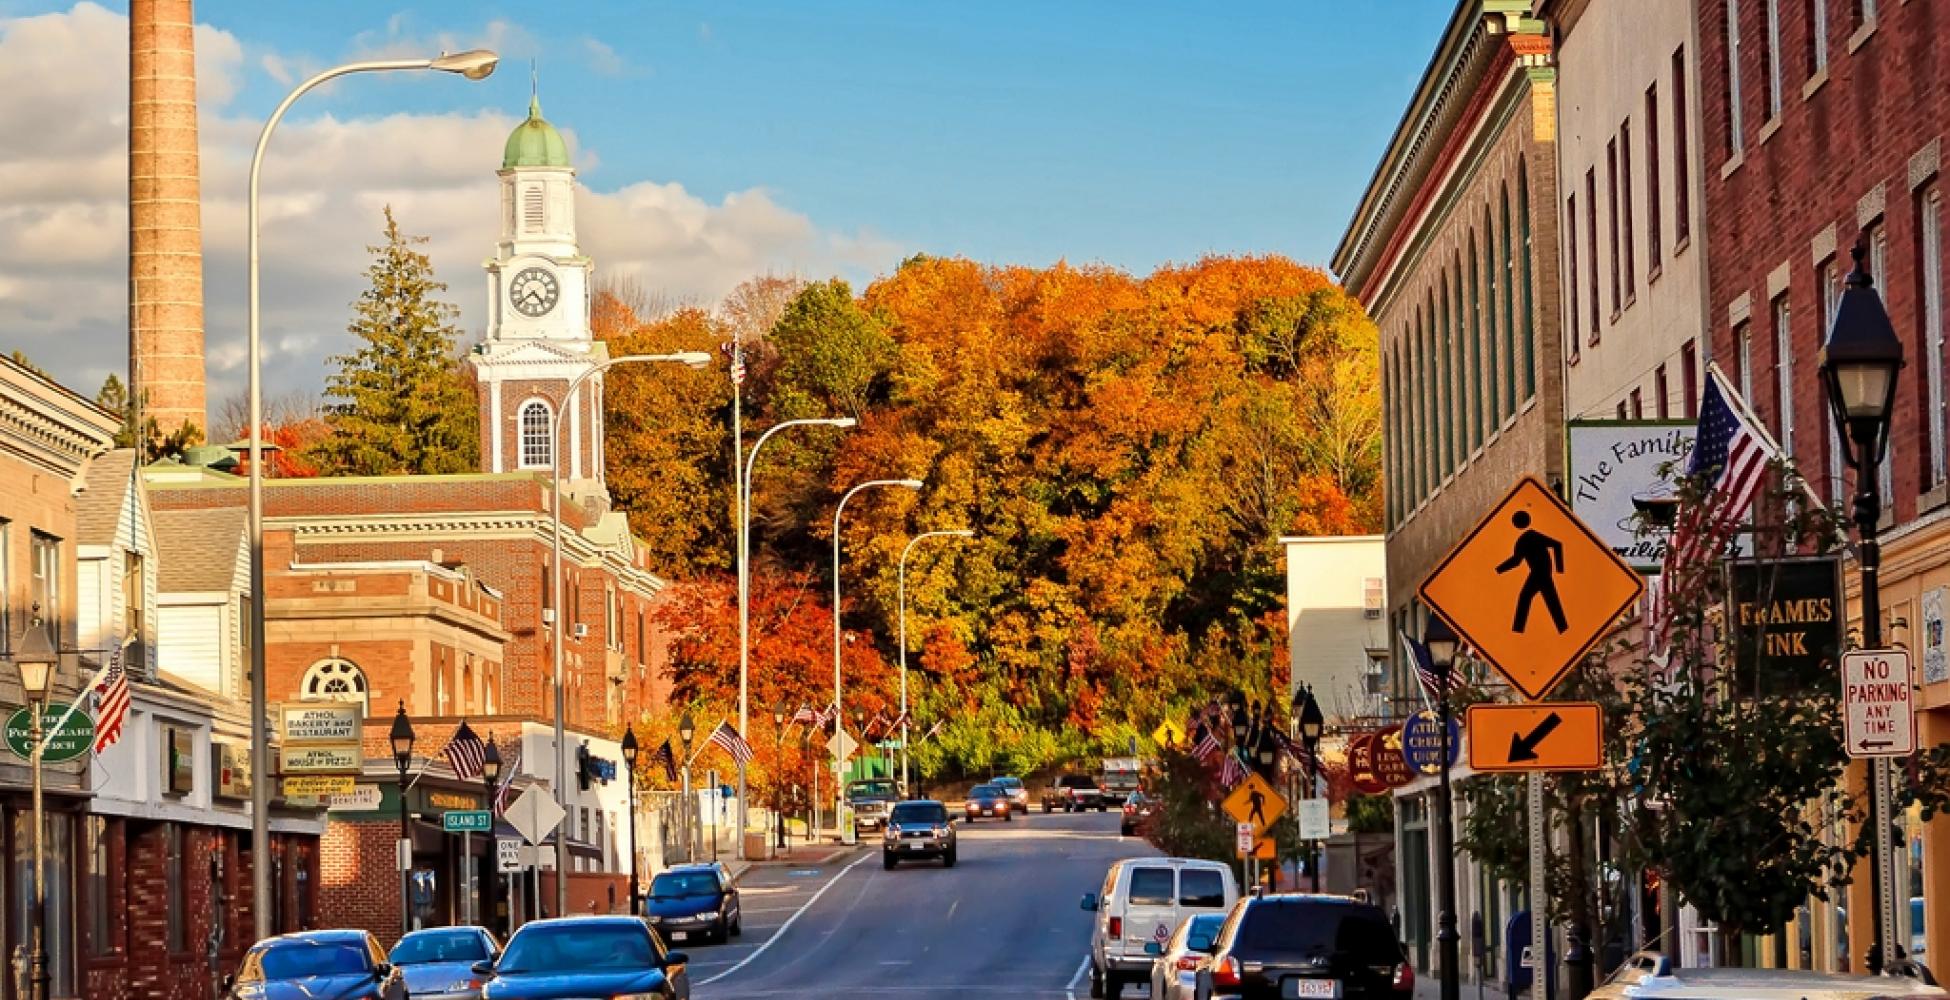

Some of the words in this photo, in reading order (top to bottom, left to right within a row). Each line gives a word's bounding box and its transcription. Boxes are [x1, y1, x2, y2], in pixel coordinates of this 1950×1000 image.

[1576, 460, 1613, 503] The
[1740, 598, 1831, 626] FRAMES
[1765, 632, 1808, 656] INK
[1864, 660, 1890, 680] NO
[1848, 682, 1907, 704] PARKING
[303, 711, 336, 719] ATHOL
[1866, 705, 1892, 718] ANY
[289, 720, 330, 728] BAKERY
[1864, 720, 1895, 734] TIME
[447, 815, 475, 826] ISLAND
[478, 815, 486, 825] ST
[500, 841, 519, 850] ONE
[500, 851, 519, 859] WAY
